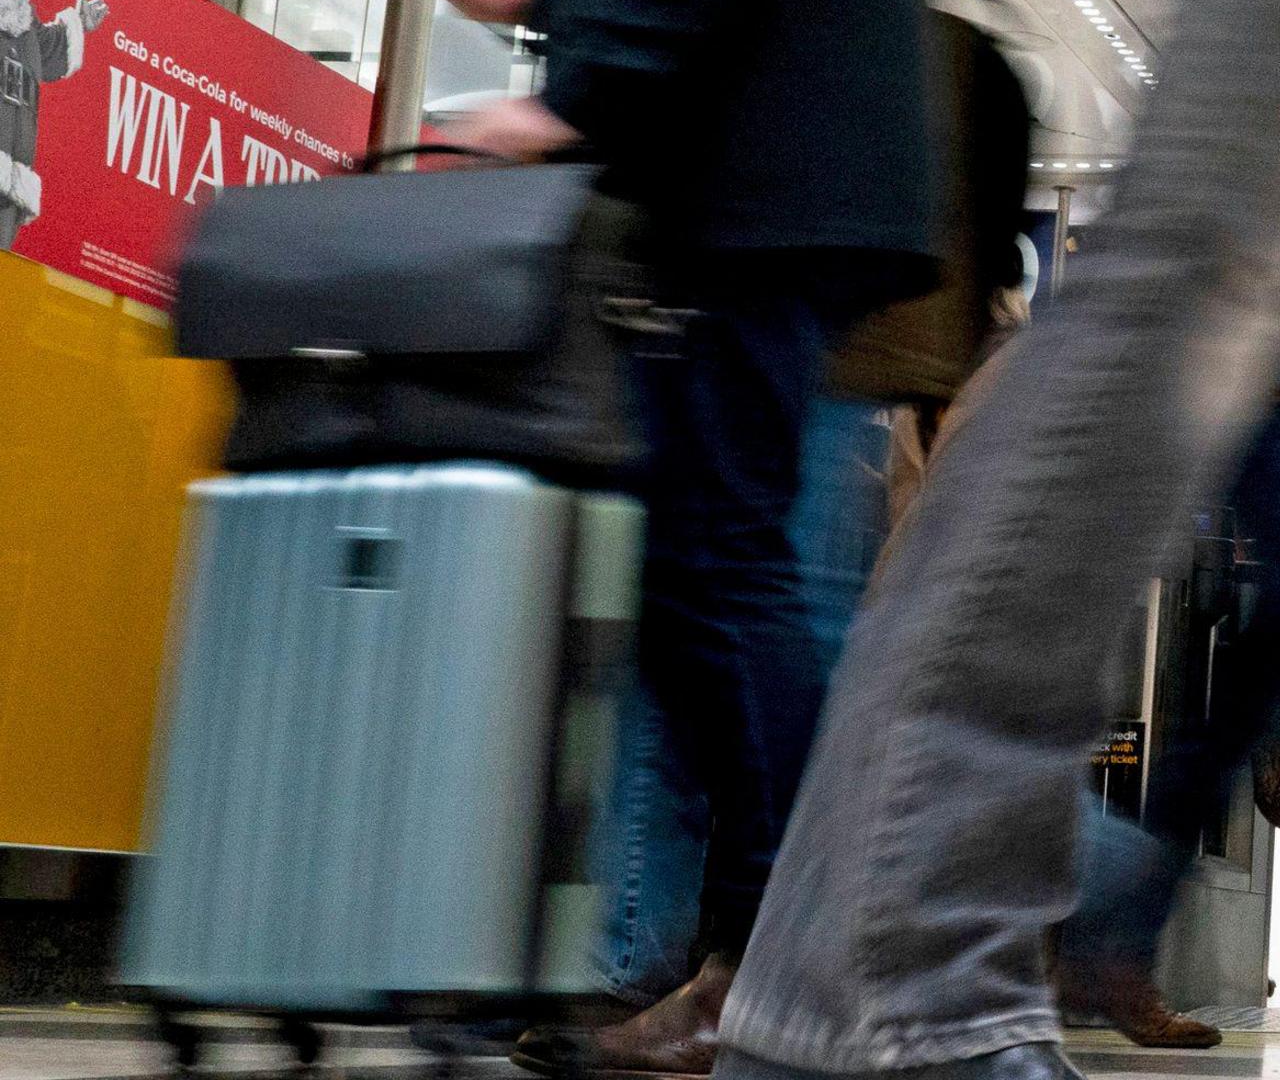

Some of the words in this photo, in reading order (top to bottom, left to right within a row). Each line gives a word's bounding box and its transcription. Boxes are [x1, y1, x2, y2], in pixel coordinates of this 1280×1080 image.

[105, 65, 191, 198] WIN
[183, 116, 225, 206] A
[113, 30, 148, 62] Grab
[150, 52, 160, 69] a
[162, 56, 227, 105] Coca-Cola
[229, 90, 249, 114] for
[250, 104, 294, 141] weekly
[294, 127, 340, 161] chances
[341, 150, 354, 171] to
[1110, 754, 1138, 765] ticket
